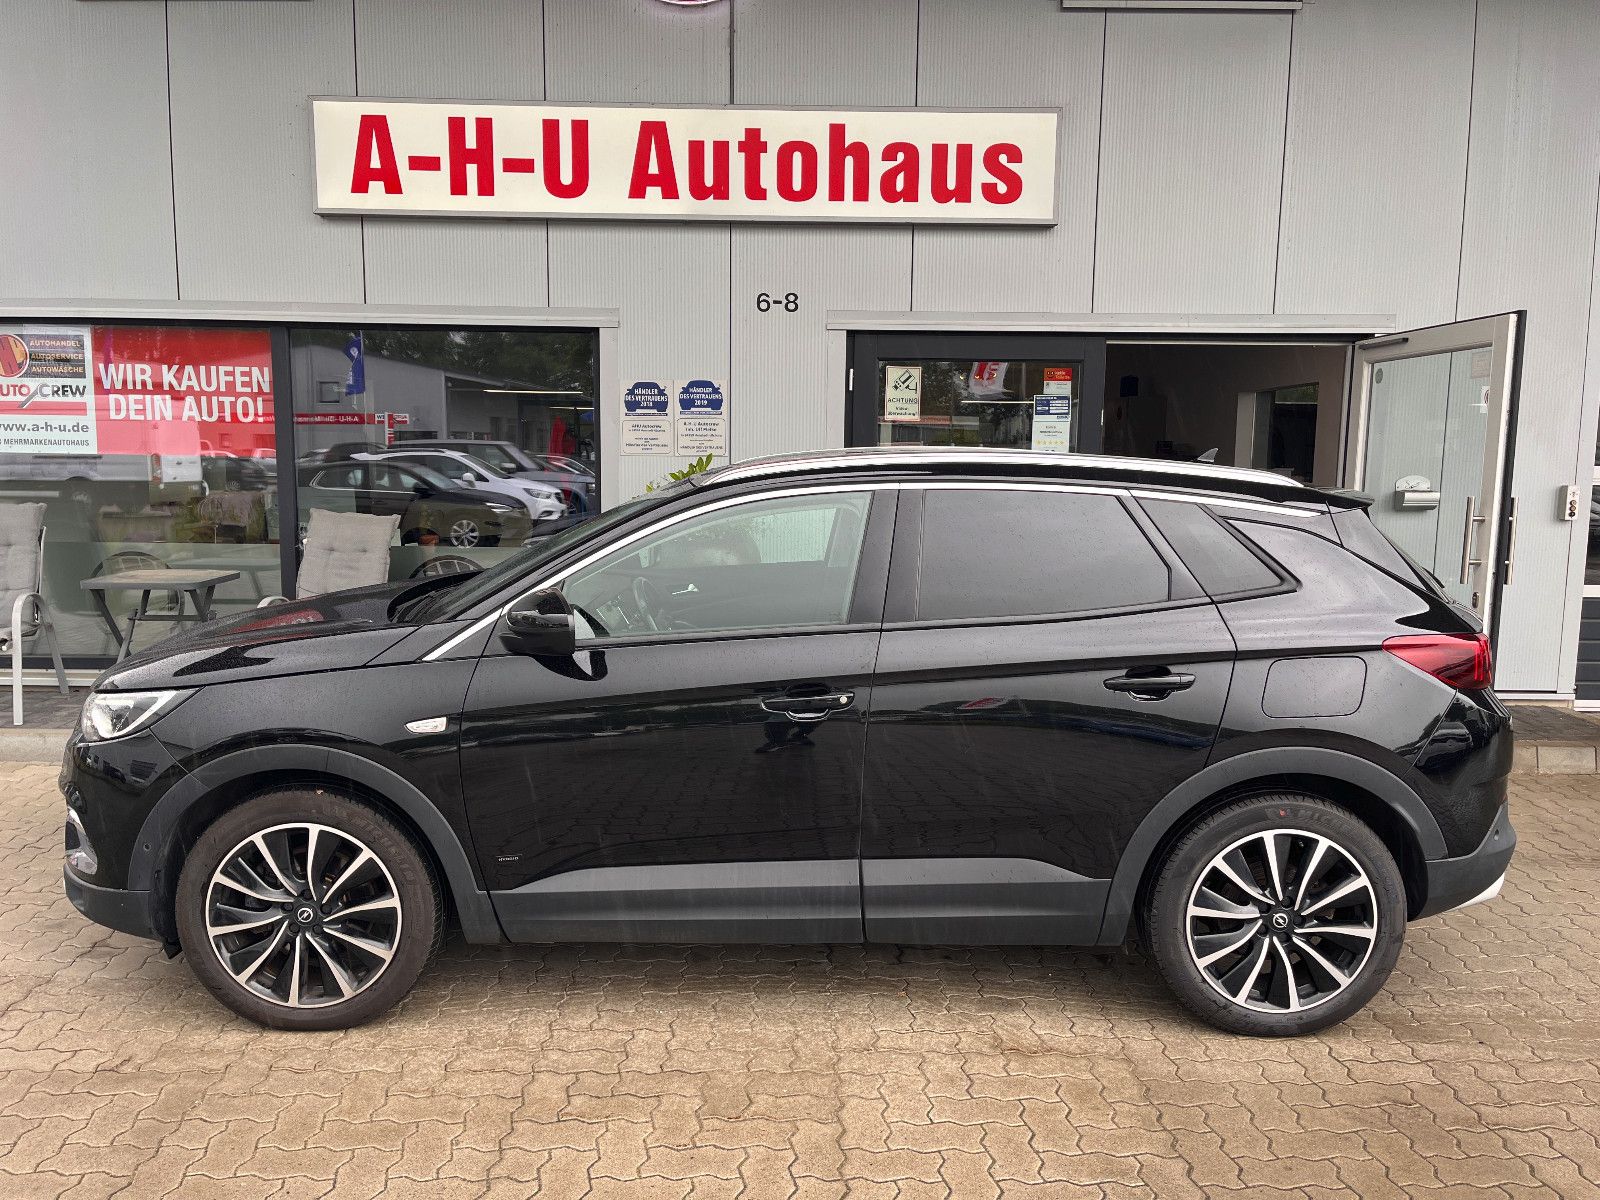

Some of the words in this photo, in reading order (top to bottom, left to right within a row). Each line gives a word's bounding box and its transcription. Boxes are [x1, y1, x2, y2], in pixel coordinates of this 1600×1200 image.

[351, 113, 590, 199] A-H-U
[627, 120, 1024, 204] Autohaus
[756, 292, 799, 313] 6-8
[99, 363, 153, 391] WIR
[162, 364, 270, 393] KAUFEN
[0, 383, 31, 397] UTO
[39, 383, 87, 398] CREW
[634, 387, 658, 395] HÄNDLER
[109, 393, 173, 421] DEIN
[182, 396, 264, 423] AUTO!
[3, 438, 90, 447] MEHRMARKENAUTOHAUS
